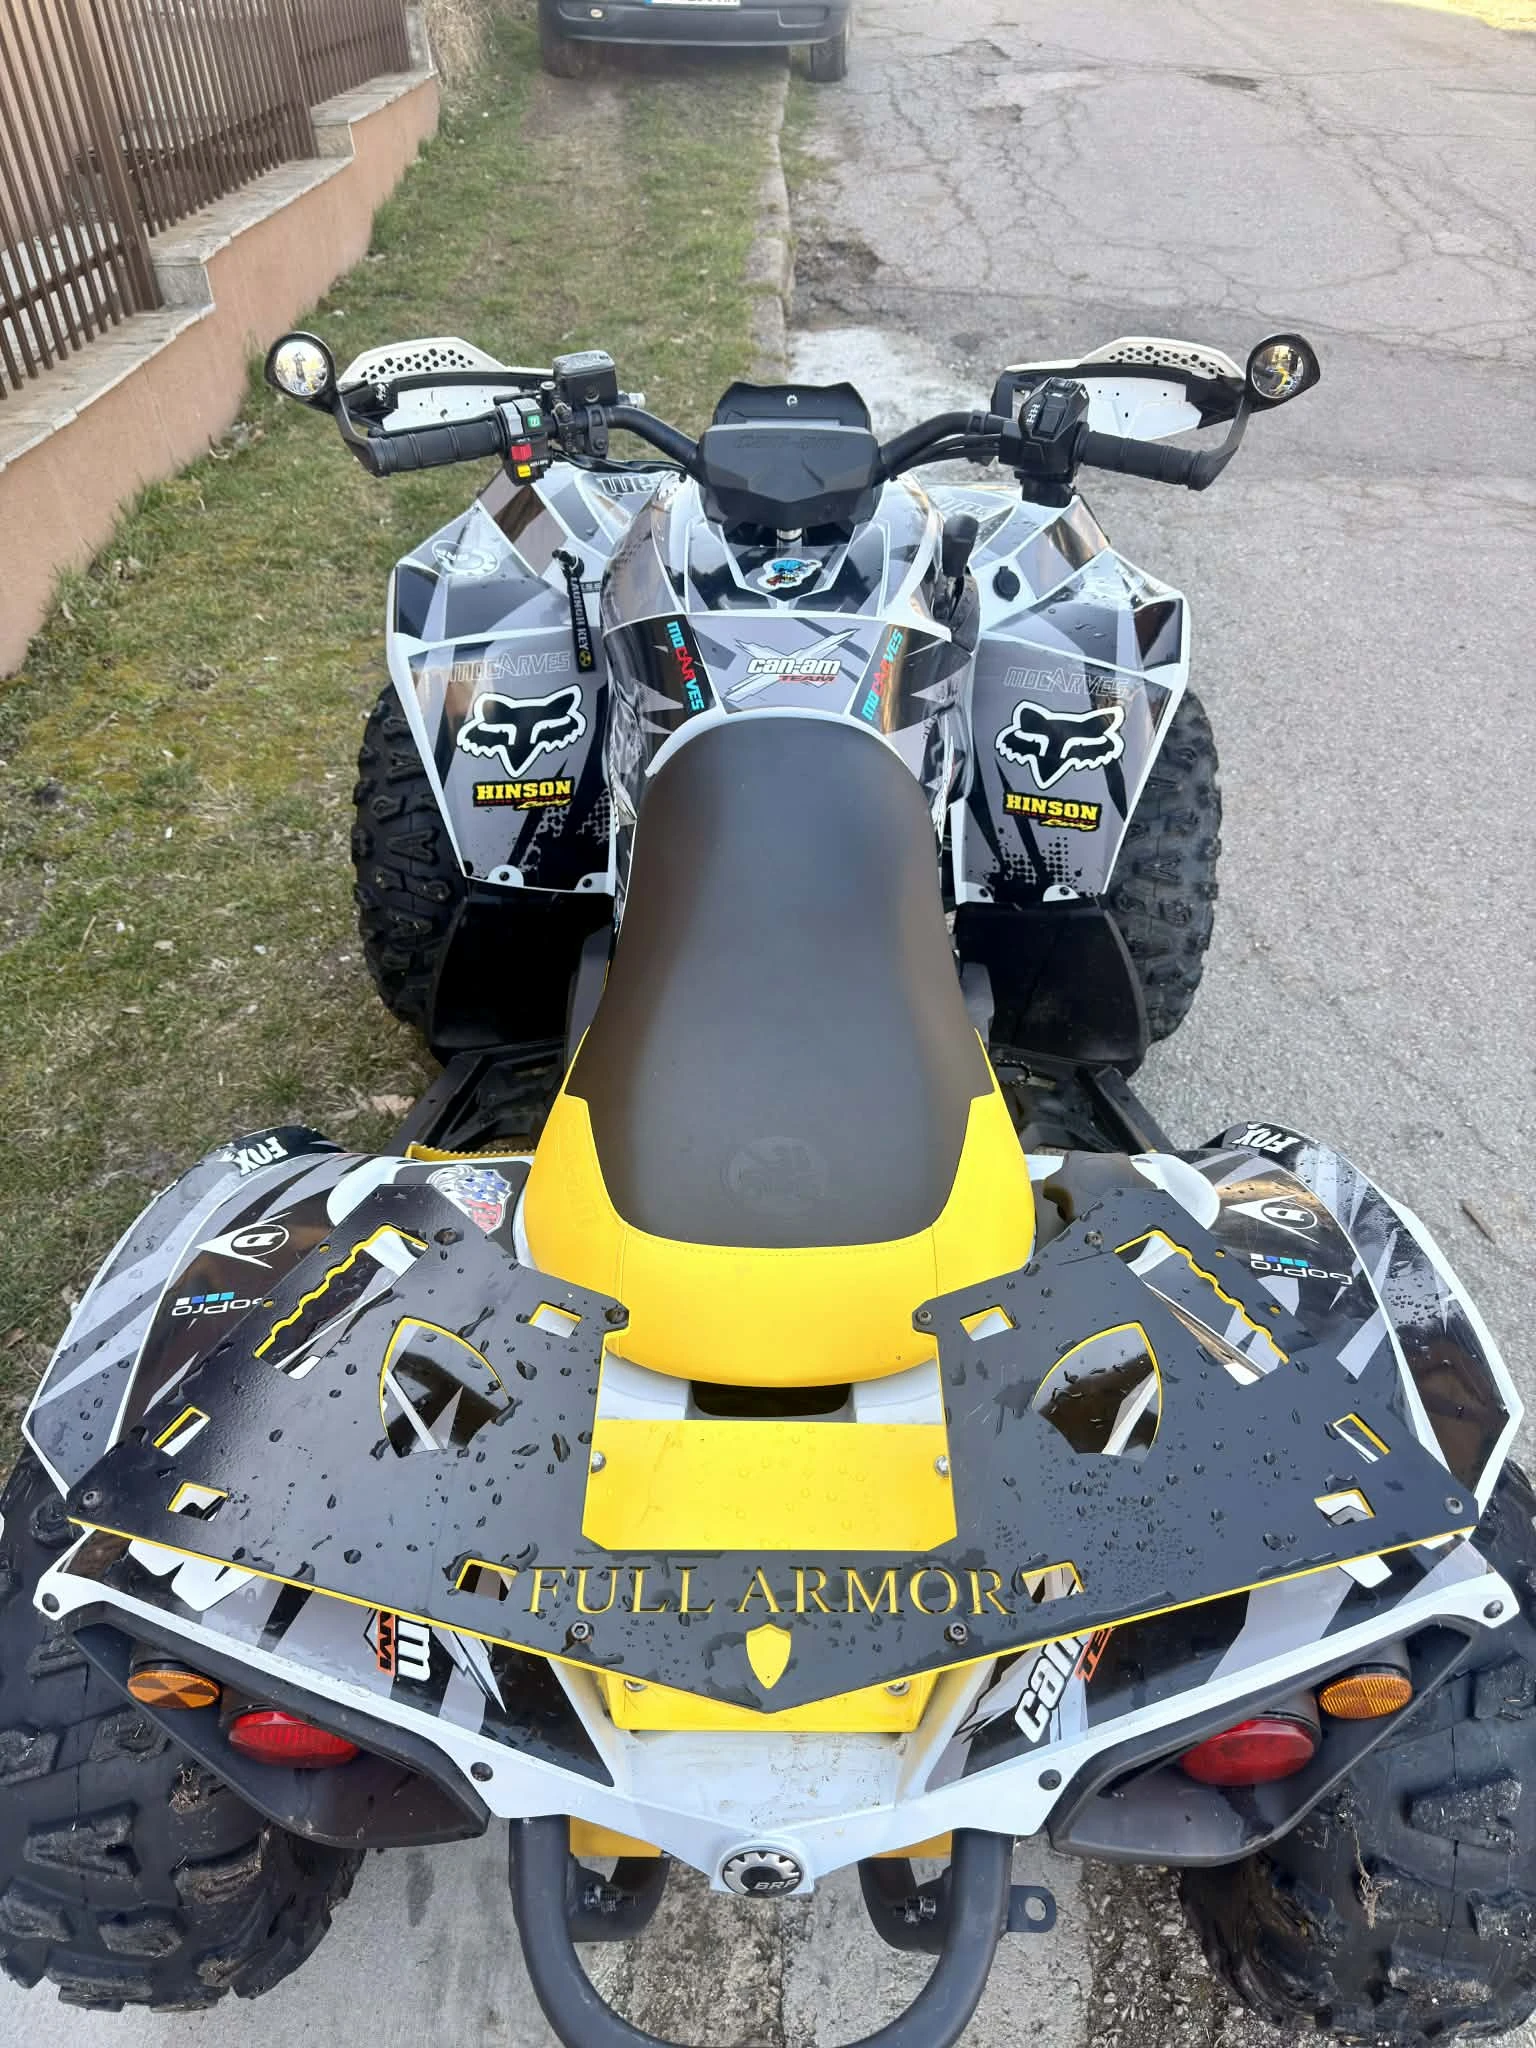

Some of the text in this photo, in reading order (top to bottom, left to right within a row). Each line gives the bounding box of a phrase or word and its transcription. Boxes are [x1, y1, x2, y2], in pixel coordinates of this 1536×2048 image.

[576, 627, 590, 650] KEY
[746, 657, 842, 675] can-am
[779, 674, 836, 684] TEAM
[475, 780, 572, 801] HINSON
[1006, 793, 1100, 821] HINSON
[1231, 1127, 1301, 1154] FOX
[230, 1135, 289, 1176] FOX
[1250, 1259, 1353, 1286] GoPro
[523, 1565, 1016, 1615] FULL ARMOR
[753, 1878, 800, 1890] BRP
